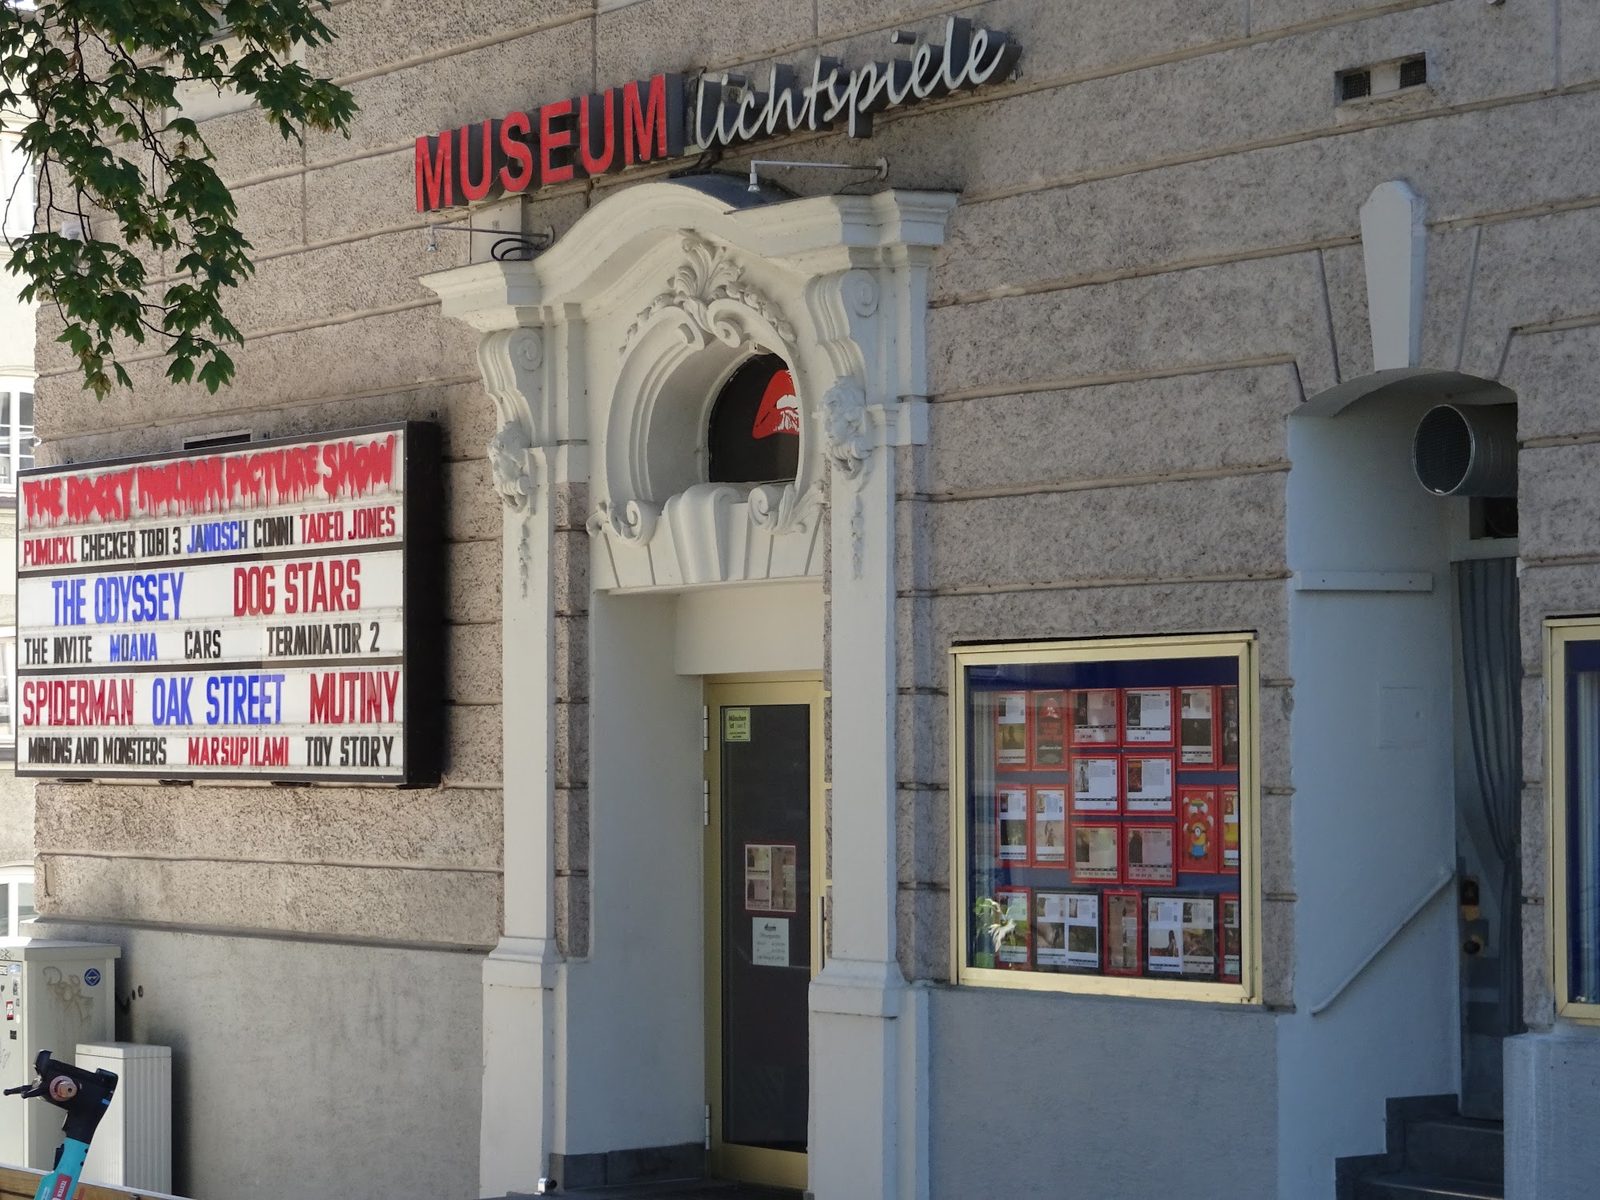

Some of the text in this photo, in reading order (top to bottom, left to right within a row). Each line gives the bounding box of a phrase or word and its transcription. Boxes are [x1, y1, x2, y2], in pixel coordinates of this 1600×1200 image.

[415, 16, 1006, 212] MUSEUM lichtspiele
[23, 477, 63, 532] THE
[226, 445, 319, 516] PICTURE
[322, 434, 395, 504] SHOW
[24, 506, 395, 566] PUMUCKL CHECKER TOBI 3 JANOSCH CONNI TADEO JONES
[52, 572, 184, 626] THE ODYSSEY
[234, 559, 361, 617] DOG STARS
[24, 635, 92, 665] THE INVITE
[109, 633, 158, 662] MOANA
[184, 630, 221, 659] CARS
[266, 622, 380, 656] TERMINATOR 2
[23, 678, 134, 726] SPIDERMAN
[152, 674, 285, 725] OAK STREET
[309, 671, 400, 724] MUTINY
[28, 737, 167, 765] MINIONS AND MONSTERS
[187, 736, 289, 766] MARSUPILAMI
[305, 736, 394, 767] TOY STORY
